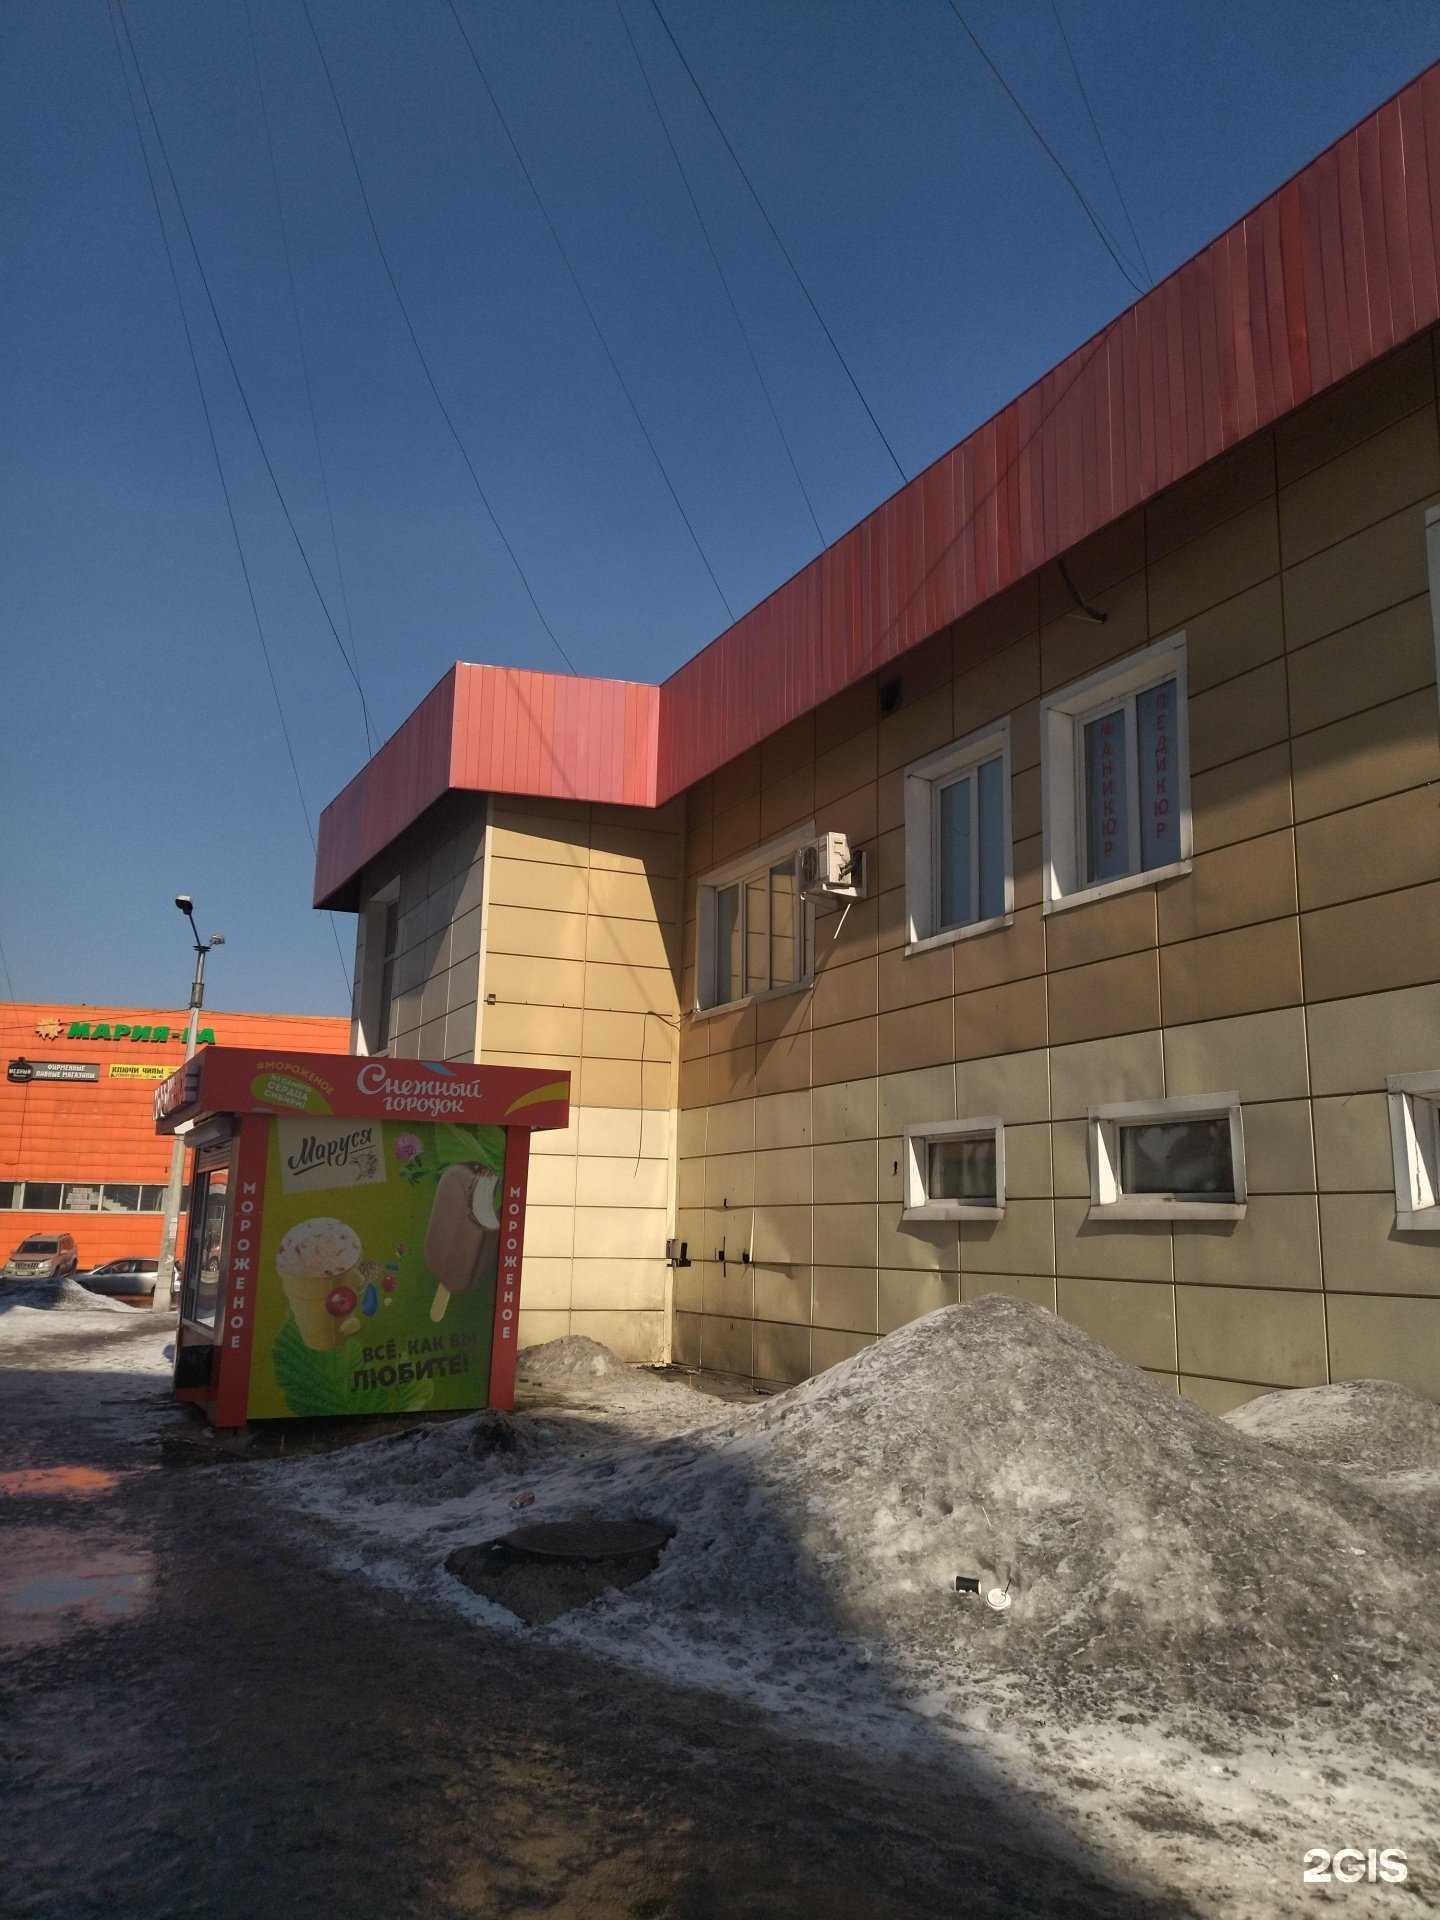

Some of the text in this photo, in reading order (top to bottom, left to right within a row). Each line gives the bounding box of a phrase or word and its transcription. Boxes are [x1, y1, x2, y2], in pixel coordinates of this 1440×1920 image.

[1154, 690, 1169, 840] ПЕДИКЮР
[111, 1066, 139, 1074] КЛЮЧИ
[356, 1063, 483, 1098] Снежный
[383, 1096, 465, 1117] городок
[287, 1127, 373, 1170] Маруся
[231, 1182, 256, 1349] МОРОЖЕНОЕ
[503, 1186, 521, 1340] МОРОЖЕНОЕ
[408, 1336, 442, 1355] КАК
